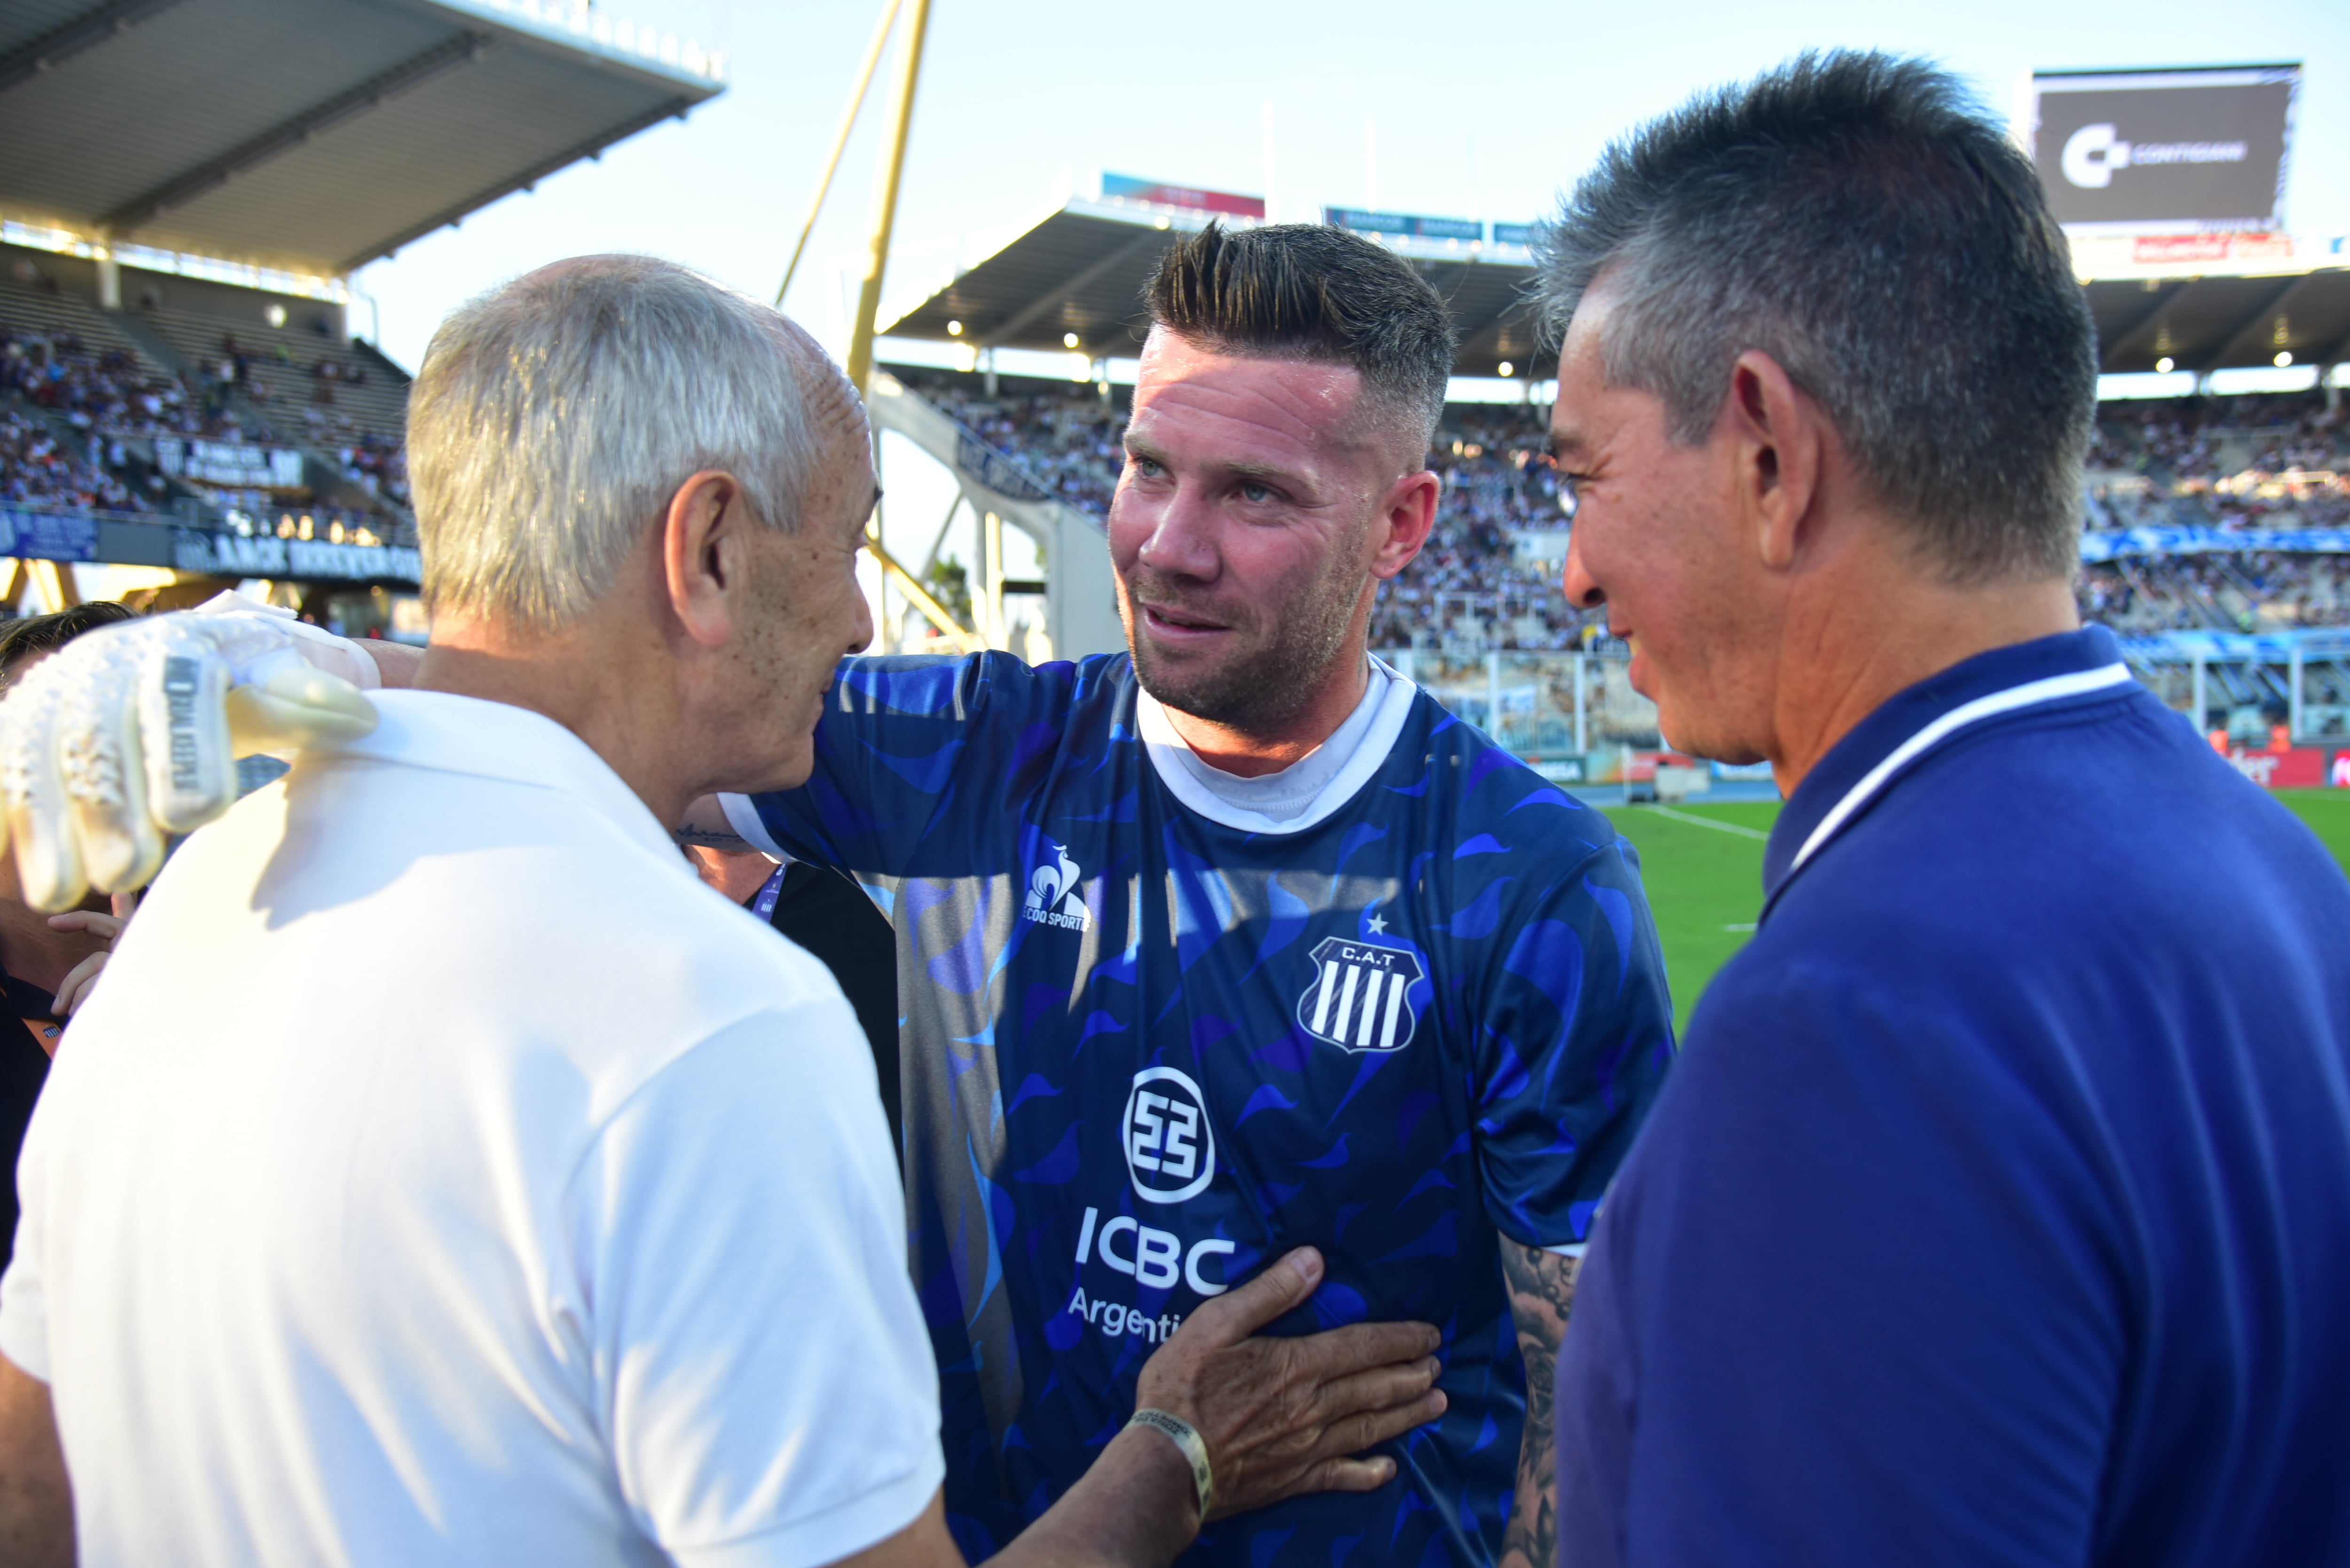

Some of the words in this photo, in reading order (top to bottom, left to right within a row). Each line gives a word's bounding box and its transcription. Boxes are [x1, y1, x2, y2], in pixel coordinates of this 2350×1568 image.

[1026, 908, 1047, 924] COQ
[1341, 947, 1395, 966] C.A.T
[1075, 1206, 1235, 1296] ICBC
